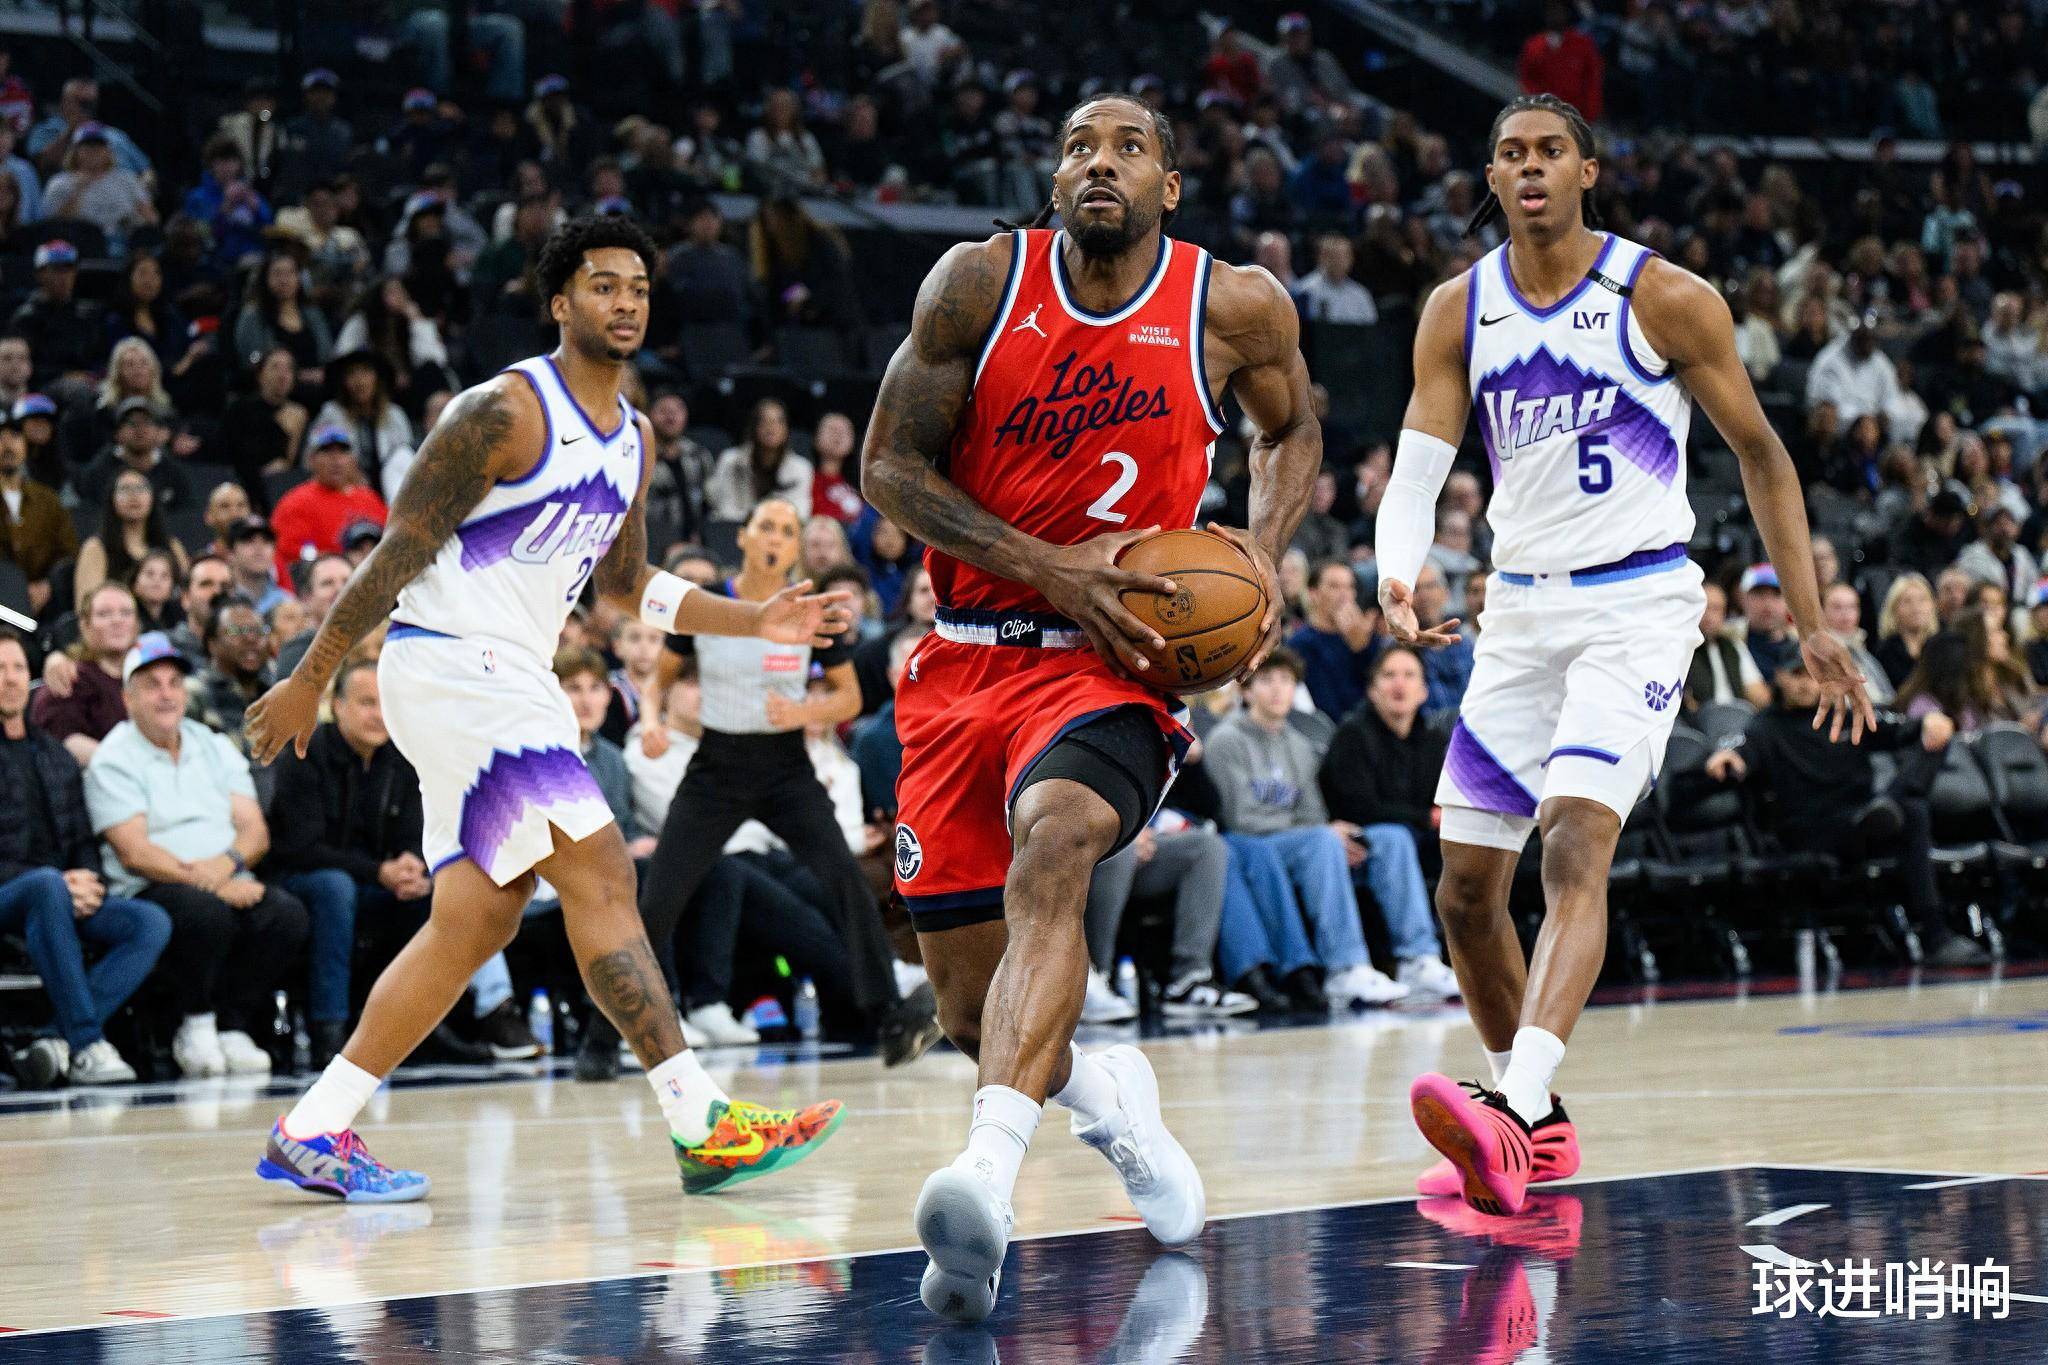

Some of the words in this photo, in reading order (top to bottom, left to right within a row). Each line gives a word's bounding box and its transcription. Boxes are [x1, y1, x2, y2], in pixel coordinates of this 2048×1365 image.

[1129, 333, 1180, 347] RWANDA
[1141, 325, 1170, 336] VISIT
[1573, 312, 1610, 329] LVT
[1045, 351, 1119, 404] Los
[992, 377, 1172, 459] Angeles
[1482, 383, 1624, 461] UTAH
[1086, 451, 1139, 524] 2
[1577, 434, 1613, 494] 5
[1001, 619, 1036, 640] Clips
